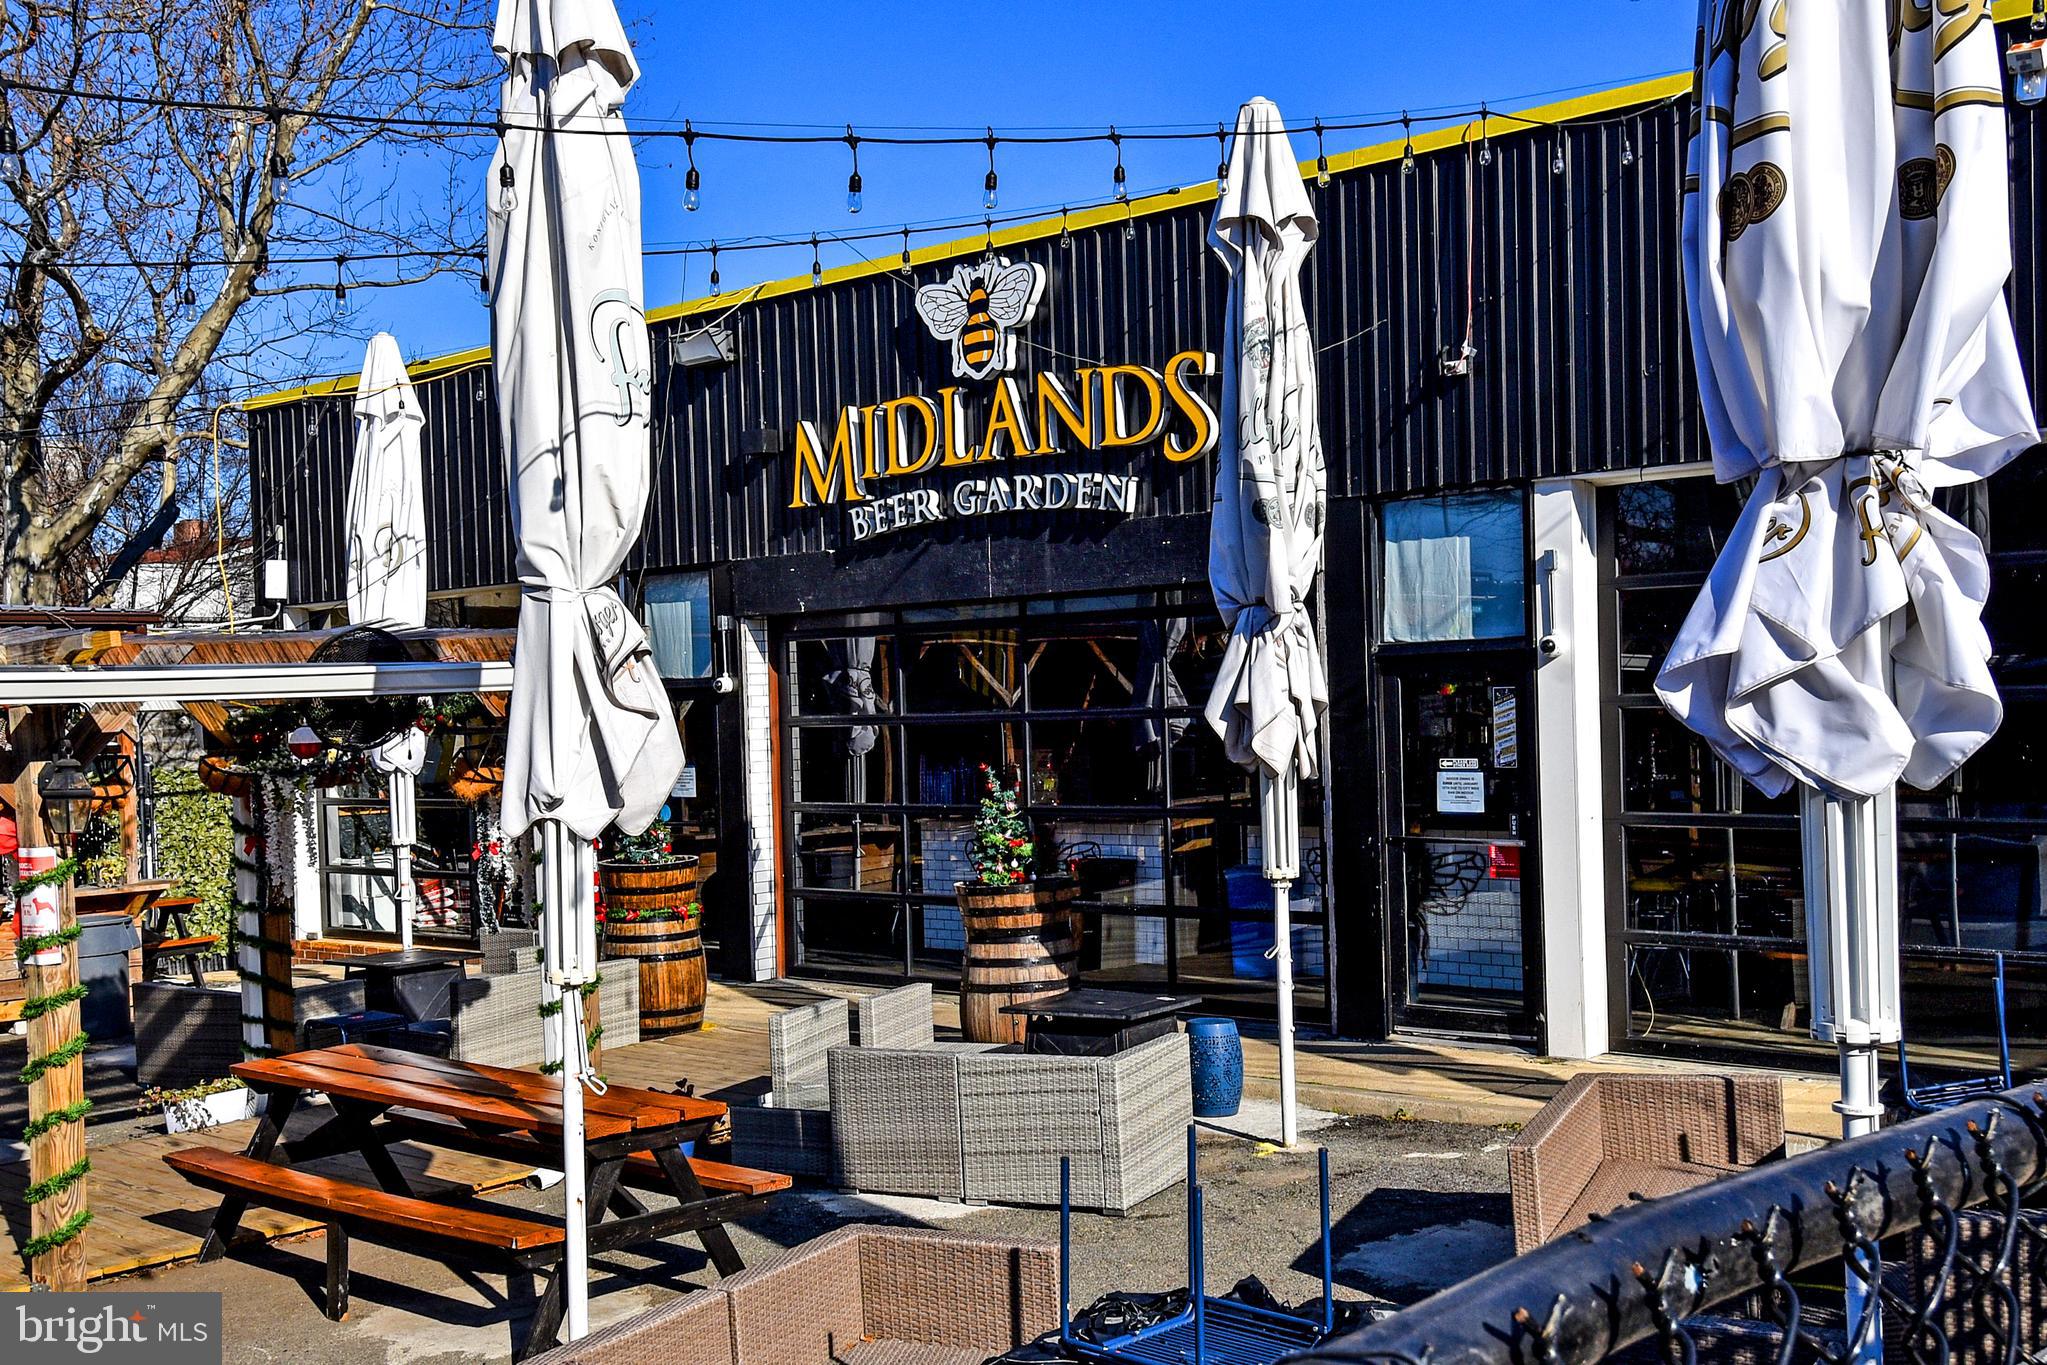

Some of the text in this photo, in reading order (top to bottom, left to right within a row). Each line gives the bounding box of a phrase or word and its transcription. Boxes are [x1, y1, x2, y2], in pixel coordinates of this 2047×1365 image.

[788, 350, 1218, 508] MIDLANDS
[849, 473, 1138, 541] BEER GARDEN
